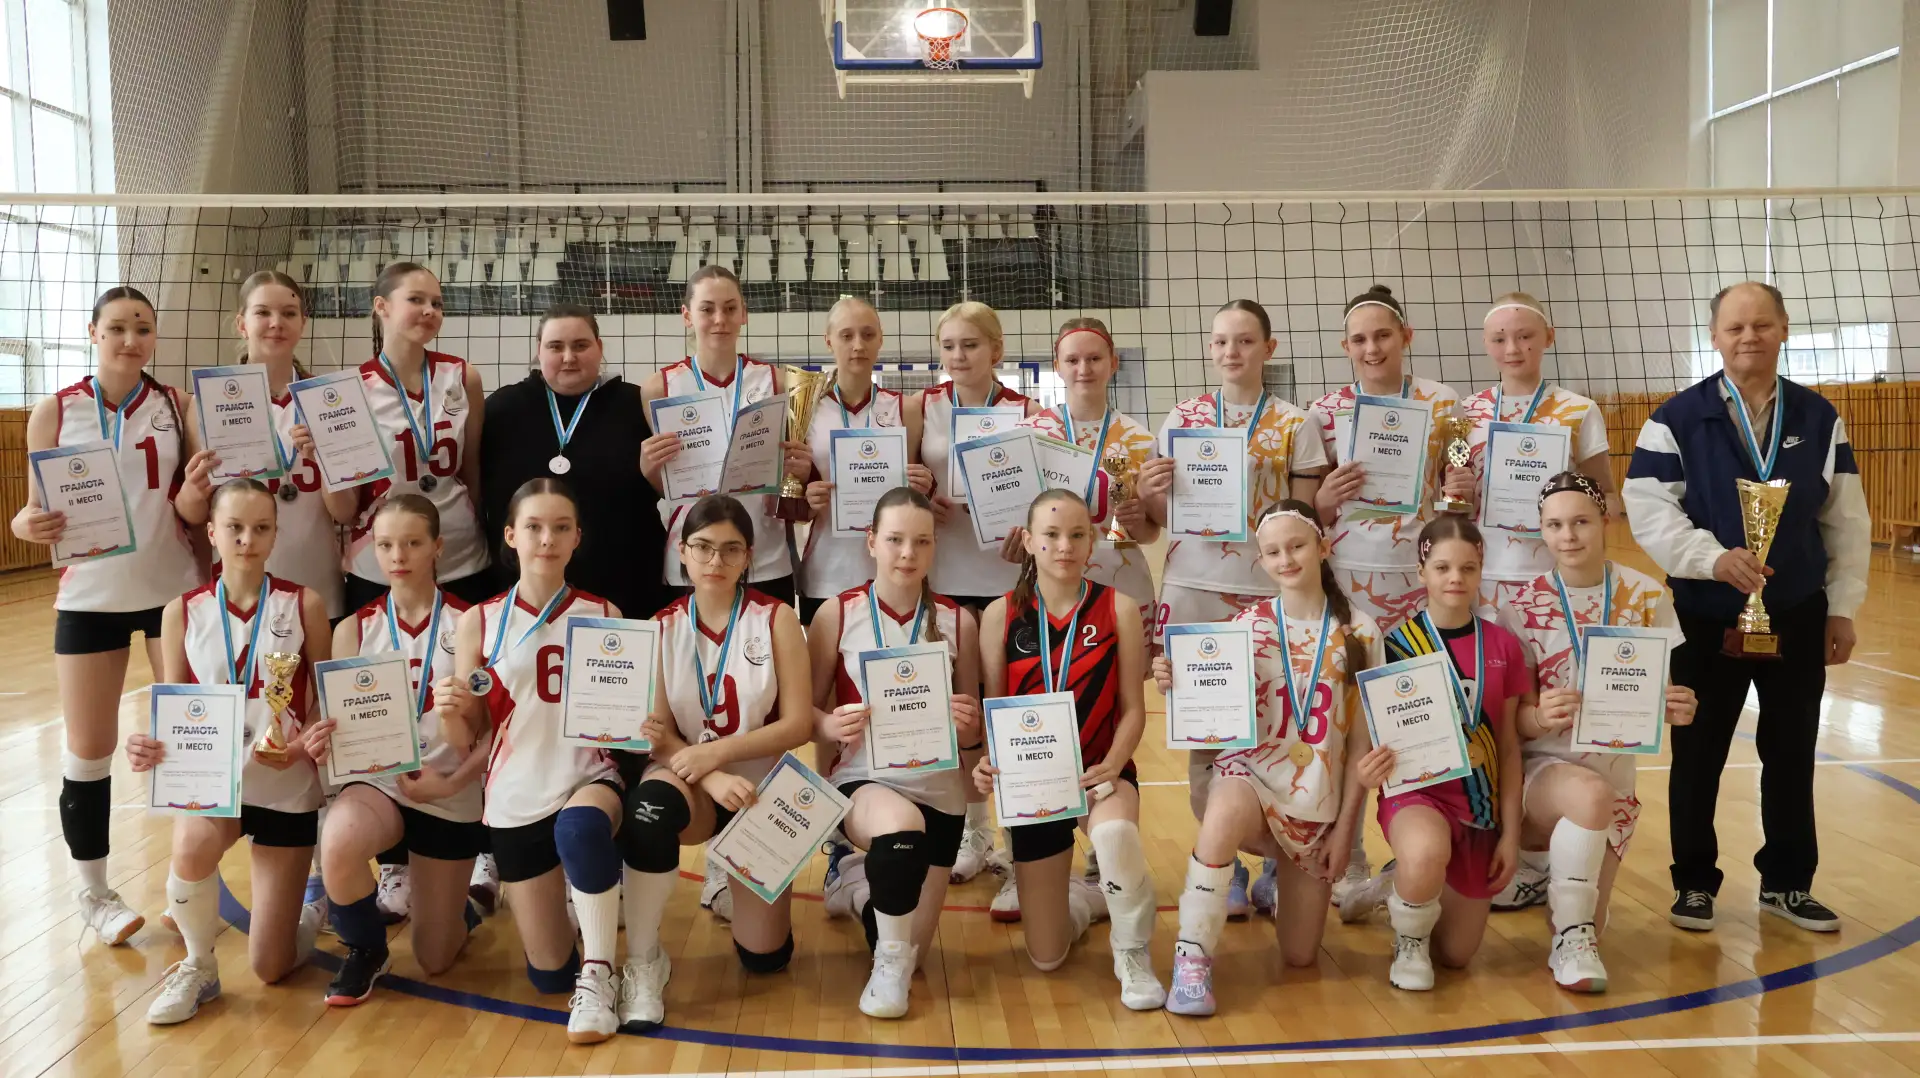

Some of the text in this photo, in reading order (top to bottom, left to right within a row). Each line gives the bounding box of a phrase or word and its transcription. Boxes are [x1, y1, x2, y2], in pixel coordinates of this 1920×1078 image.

[216, 402, 254, 412] ГРАМОТА
[318, 406, 356, 422] ГРАМОТА
[229, 416, 252, 426] МЕСТО
[334, 420, 356, 432] МЕСТО
[676, 425, 712, 438] РАМОТА
[740, 427, 770, 440] ГРАМОТА
[1368, 432, 1409, 443] ГРАМОТА
[395, 420, 458, 482] 15
[687, 440, 710, 450] МЕСТО
[746, 440, 765, 450] МЕСТО
[1378, 447, 1402, 456] МЕСТО
[136, 436, 160, 490] 1
[849, 462, 889, 471] ГРАМОТА
[1187, 464, 1228, 472] ГРАМОТА
[1505, 458, 1548, 469] ГРАМОТА
[982, 465, 1023, 481] ГРАМОТА
[1515, 474, 1540, 482] МЕСТО
[60, 478, 104, 494] ГРАМОТА
[996, 480, 1020, 492] МЕСТО
[76, 494, 103, 505] МЕСТО
[1082, 624, 1098, 647] 2
[586, 658, 634, 670] ГРАМОТА
[1187, 662, 1233, 672] ГРАМОТА
[536, 644, 564, 703] 6
[1601, 667, 1647, 677] ГРАМОТА
[600, 676, 628, 685] МЕСТО
[884, 684, 931, 698] ГРАМОТА
[1612, 684, 1640, 692] МЕСТО
[343, 692, 392, 707] ГРАМОТА
[700, 673, 740, 736] 9
[1386, 696, 1434, 715] ГРАМОТА
[899, 701, 927, 712] МЕСТО
[359, 708, 388, 720] МЕСТО
[1402, 713, 1430, 726] МЕСТО
[172, 726, 218, 735] ГРАМОТА
[1010, 734, 1057, 747] ГРАМОТА
[186, 743, 213, 751] МЕСТО
[1025, 751, 1053, 761] МЕСТО
[773, 796, 811, 830] ГРАМОТА
[773, 818, 797, 839] МЕСТО
